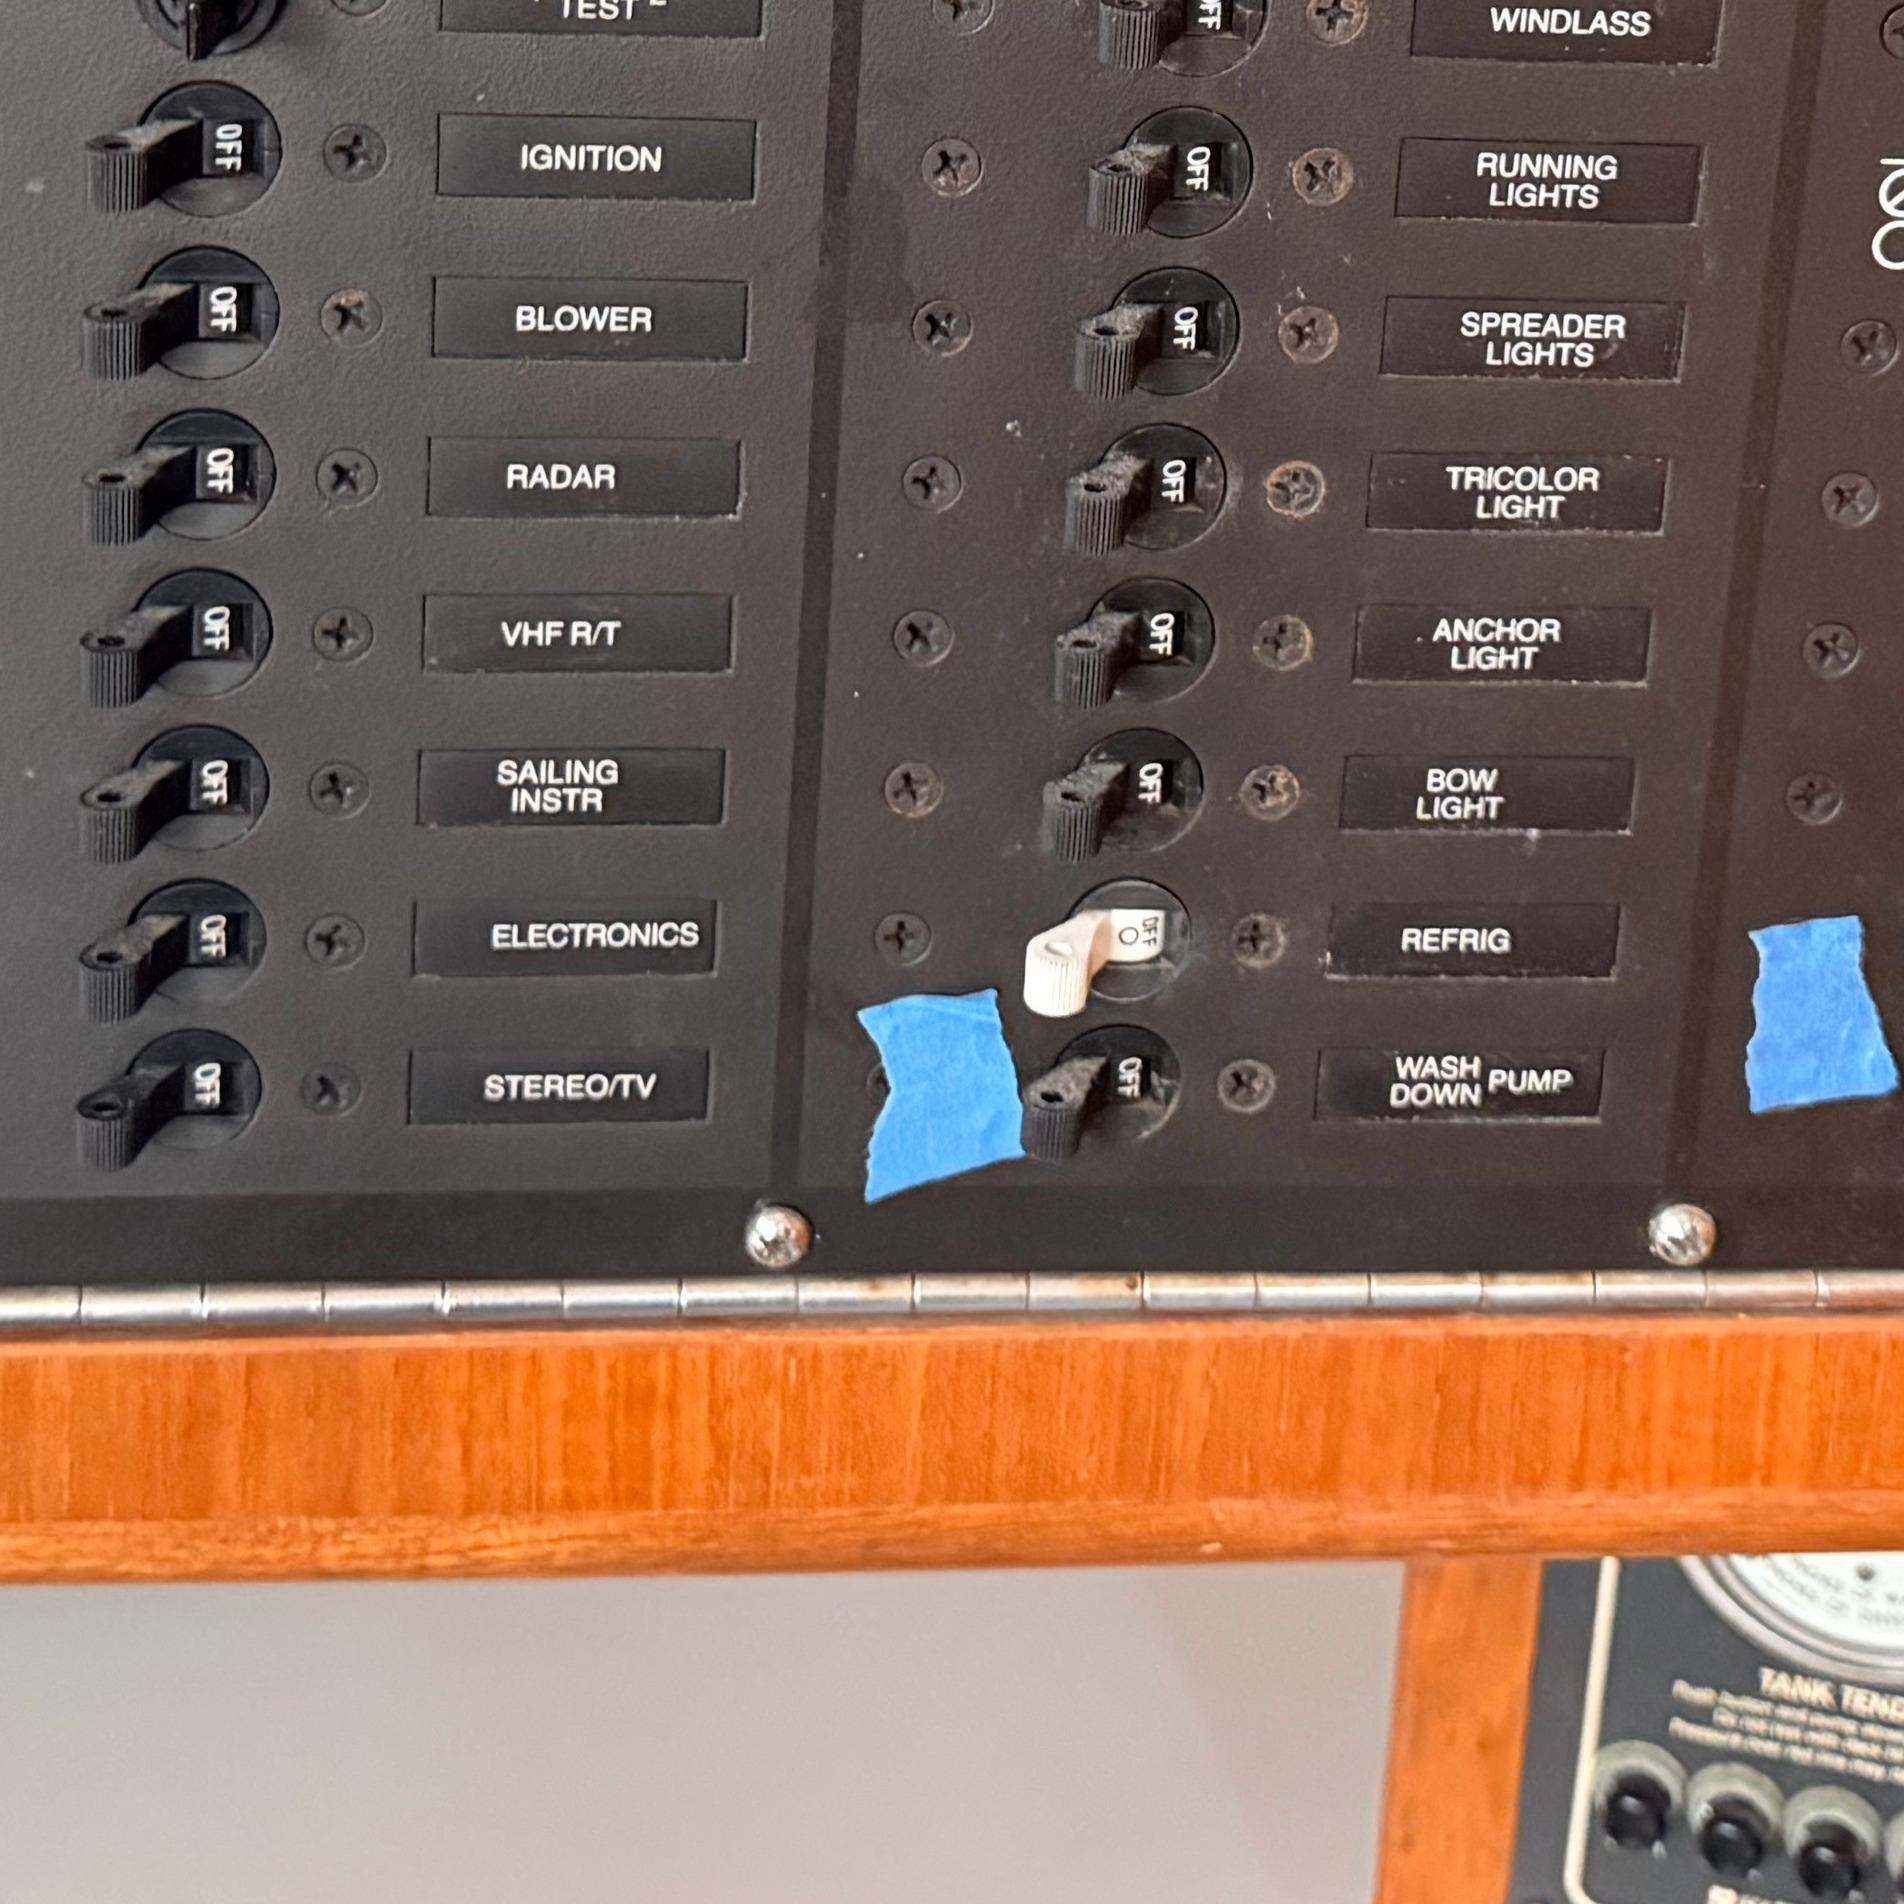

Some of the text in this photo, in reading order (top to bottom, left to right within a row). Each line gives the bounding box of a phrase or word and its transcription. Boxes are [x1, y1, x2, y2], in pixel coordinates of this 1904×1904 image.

[1490, 8, 1651, 37] WINDLASS
[214, 122, 244, 173] OFF
[520, 143, 663, 173] IGNITION
[1186, 147, 1212, 192] OFF
[1476, 153, 1619, 181] RUNNING
[1488, 182, 1600, 210] LIGHTS
[208, 286, 239, 334] OFF
[514, 304, 652, 334] BLOWER
[1172, 306, 1200, 351] OFF
[1460, 312, 1627, 340] SPREADER
[1485, 339, 1596, 368] LIGHTS
[205, 448, 236, 496] OFF
[506, 464, 616, 491] RADAR
[1161, 459, 1188, 504] OFF
[1446, 467, 1600, 493] TRICOLOR
[1475, 494, 1565, 520] LIGHT
[501, 621, 622, 646] VHF R/T
[1149, 613, 1176, 656] OFF
[1431, 619, 1561, 644] ANCHOR
[1450, 645, 1539, 671] LIGHT
[496, 760, 619, 787] SAILING
[1426, 769, 1497, 793] BOW
[510, 787, 604, 814] INSTR
[1417, 795, 1504, 821] LIGHT
[490, 923, 700, 949] ELECTRONICS
[1401, 928, 1512, 954] REFRIG
[1394, 1056, 1482, 1080] WASH
[1488, 1068, 1575, 1094] PUMP
[483, 1074, 658, 1101] STEREO/TV
[1390, 1080, 1483, 1107] DOWN
[1757, 1667, 1837, 1710] TANK
